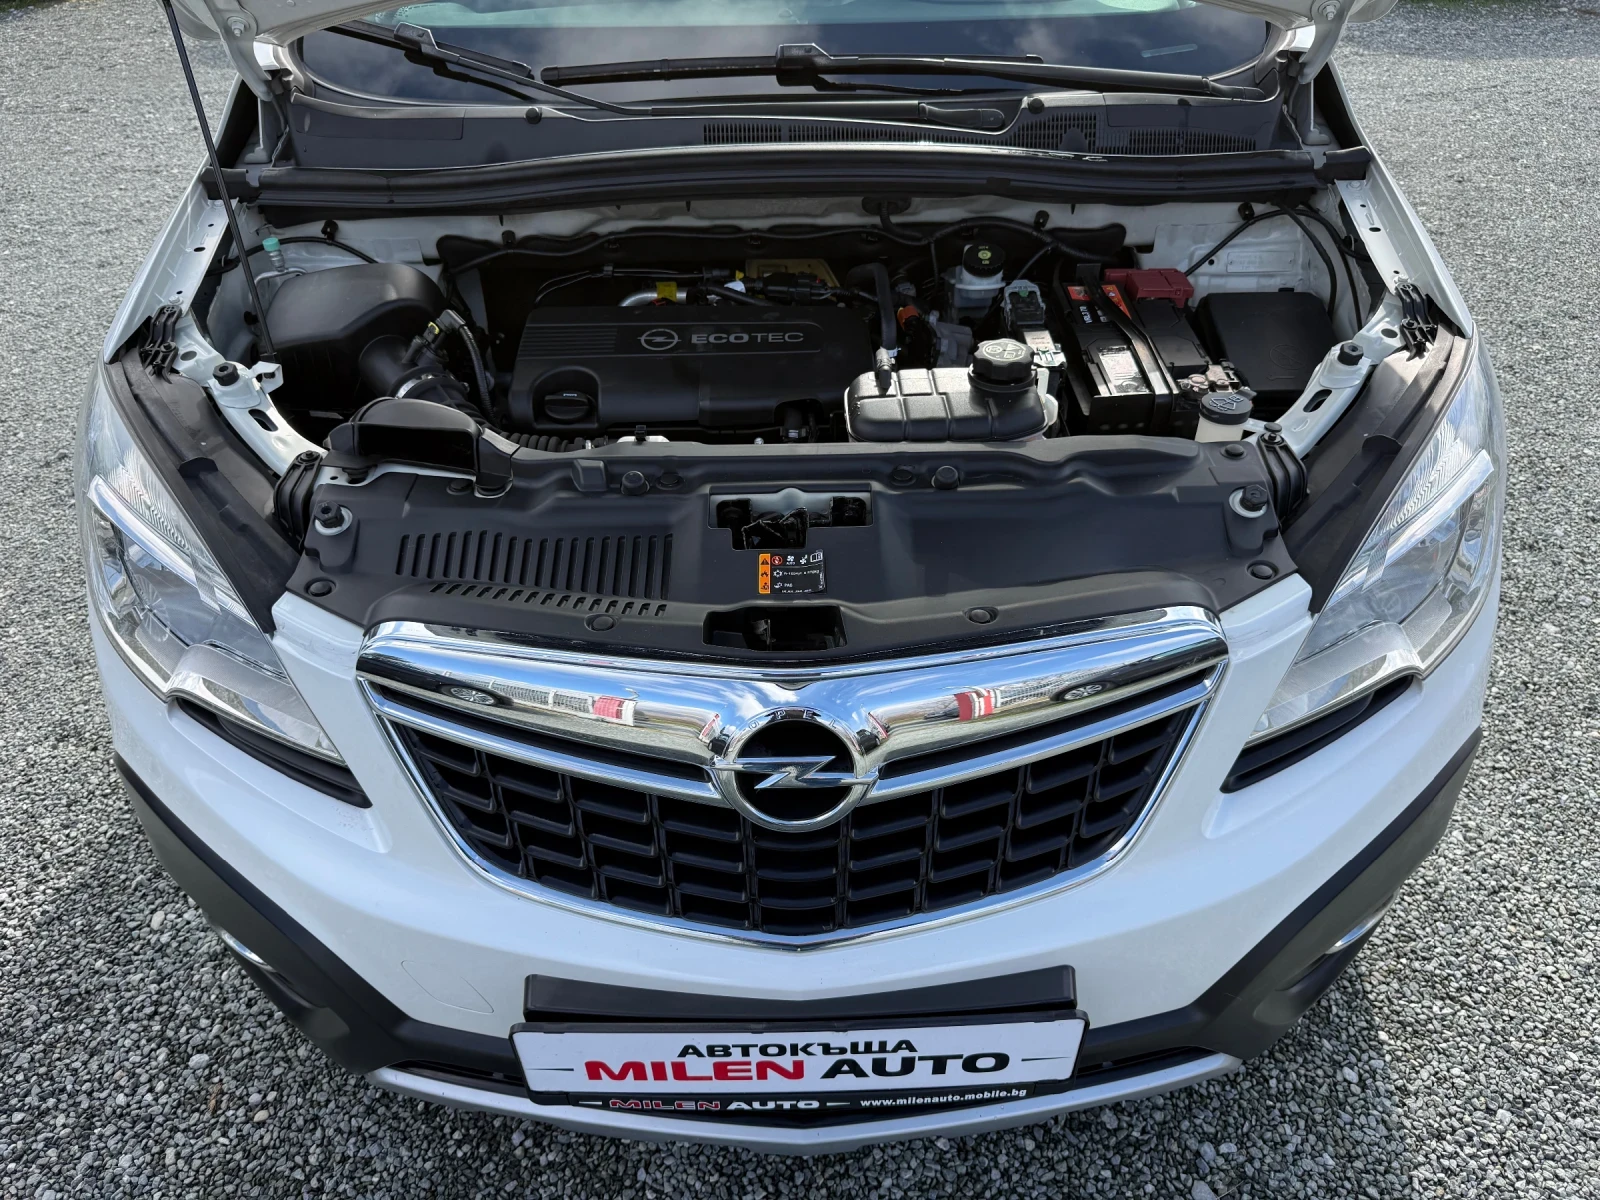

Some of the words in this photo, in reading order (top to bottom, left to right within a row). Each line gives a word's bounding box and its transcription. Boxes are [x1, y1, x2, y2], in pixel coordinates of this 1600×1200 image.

[691, 332, 804, 344] ECOTEC
[748, 709, 837, 730] OPEL
[677, 1039, 918, 1058] АВТОКЪША
[584, 1060, 805, 1082] MILEN
[820, 1052, 1010, 1080] AUTO
[609, 1098, 721, 1111] MILEN
[726, 1100, 820, 1110] AUTO
[860, 1088, 1027, 1108] www.milenauto.mobile.bg
